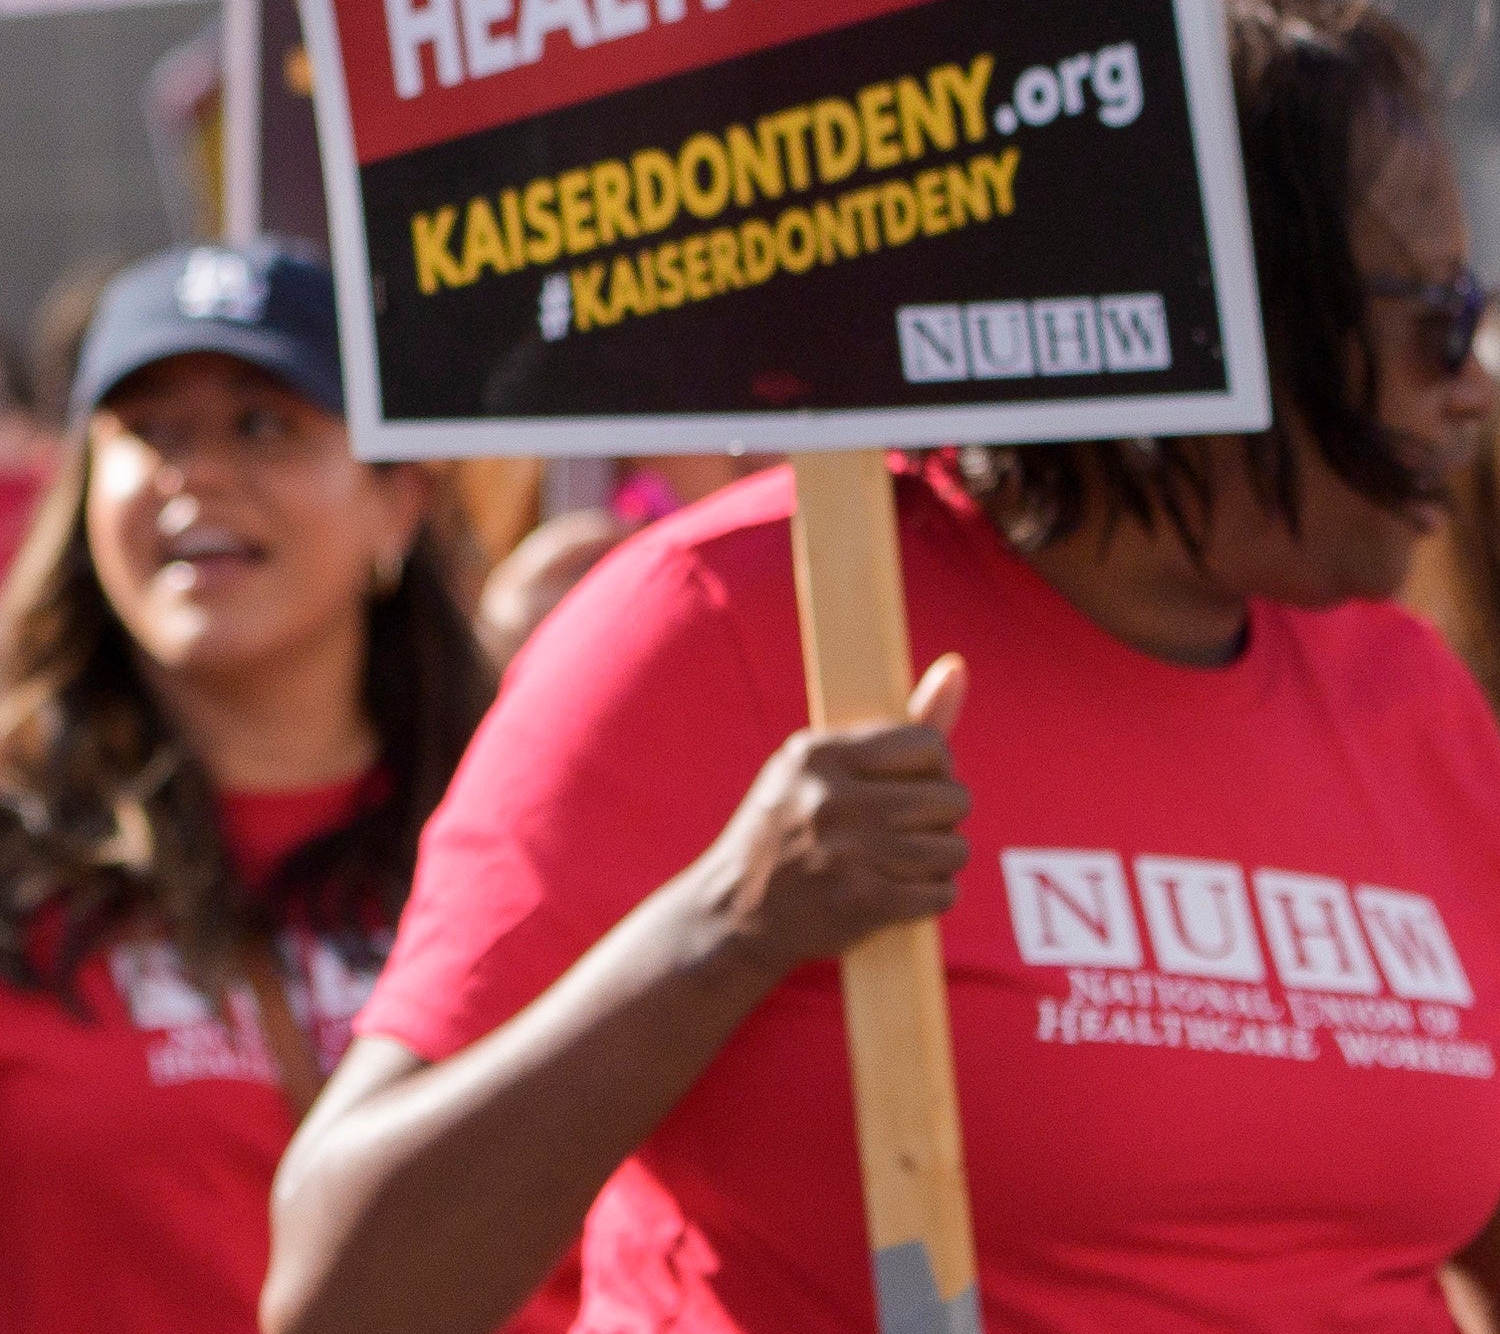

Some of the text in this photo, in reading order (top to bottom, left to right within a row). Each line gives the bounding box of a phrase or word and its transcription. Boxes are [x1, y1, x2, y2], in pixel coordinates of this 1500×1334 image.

[410, 41, 1145, 296] KAISERDONTDENY.org
[538, 147, 1023, 341] #KAISERDONTDENY
[900, 297, 1169, 381] NUHW
[1002, 847, 1474, 1009] NUHW
[1036, 997, 1322, 1062] HEALTHCARE
